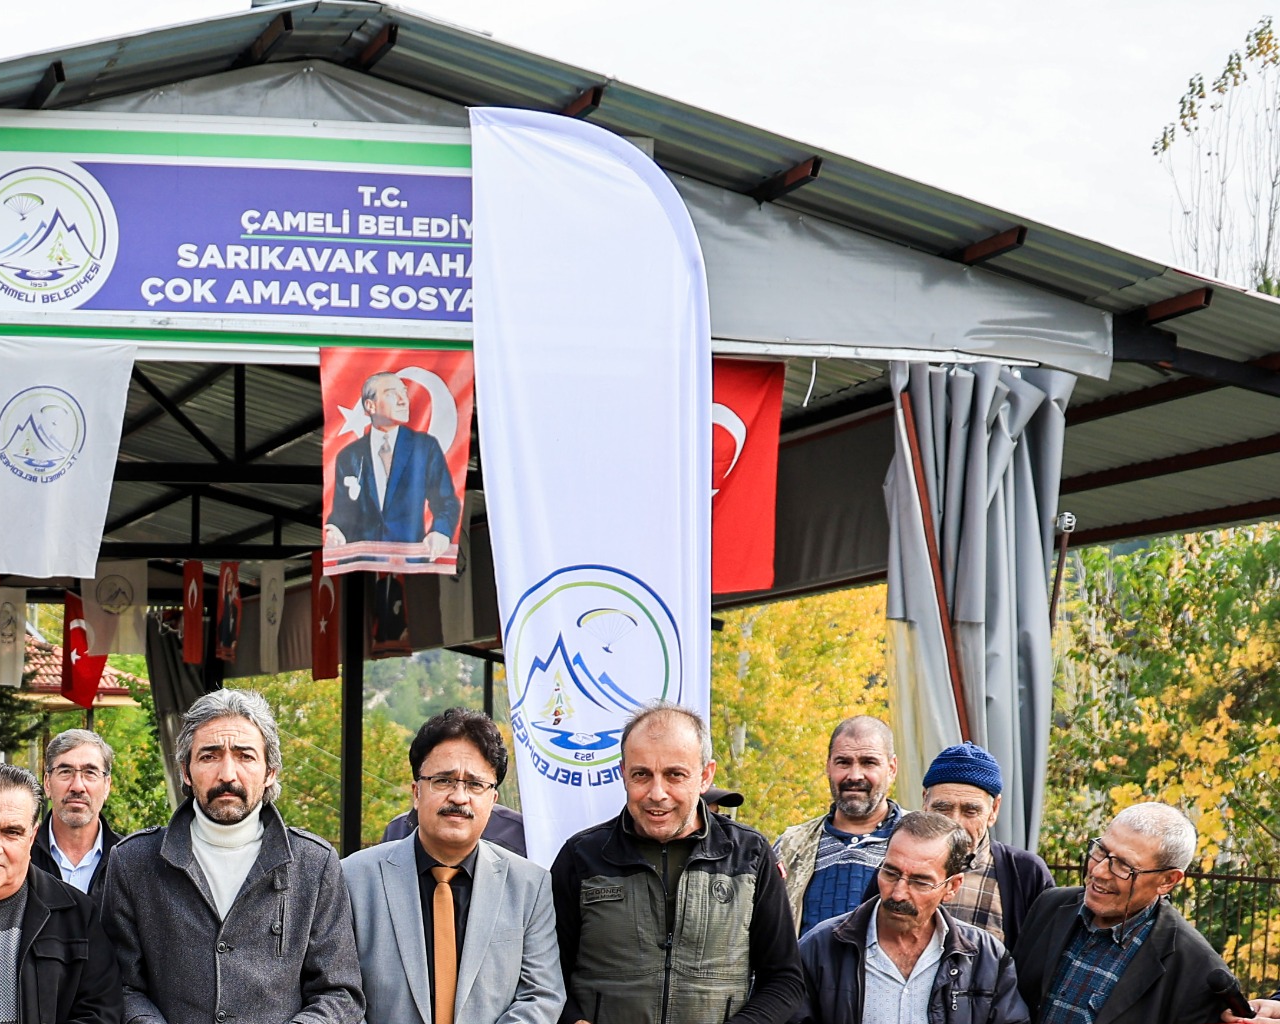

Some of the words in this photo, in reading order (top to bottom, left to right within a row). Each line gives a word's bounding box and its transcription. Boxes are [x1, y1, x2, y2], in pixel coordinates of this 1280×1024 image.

[358, 186, 408, 208] T.C.
[241, 209, 350, 234] ÇAMELİ
[358, 214, 473, 239] BELEDİY
[177, 243, 379, 274] SARIKAVAK
[140, 277, 217, 306] ÇOK
[225, 280, 360, 311] AMAÇLI
